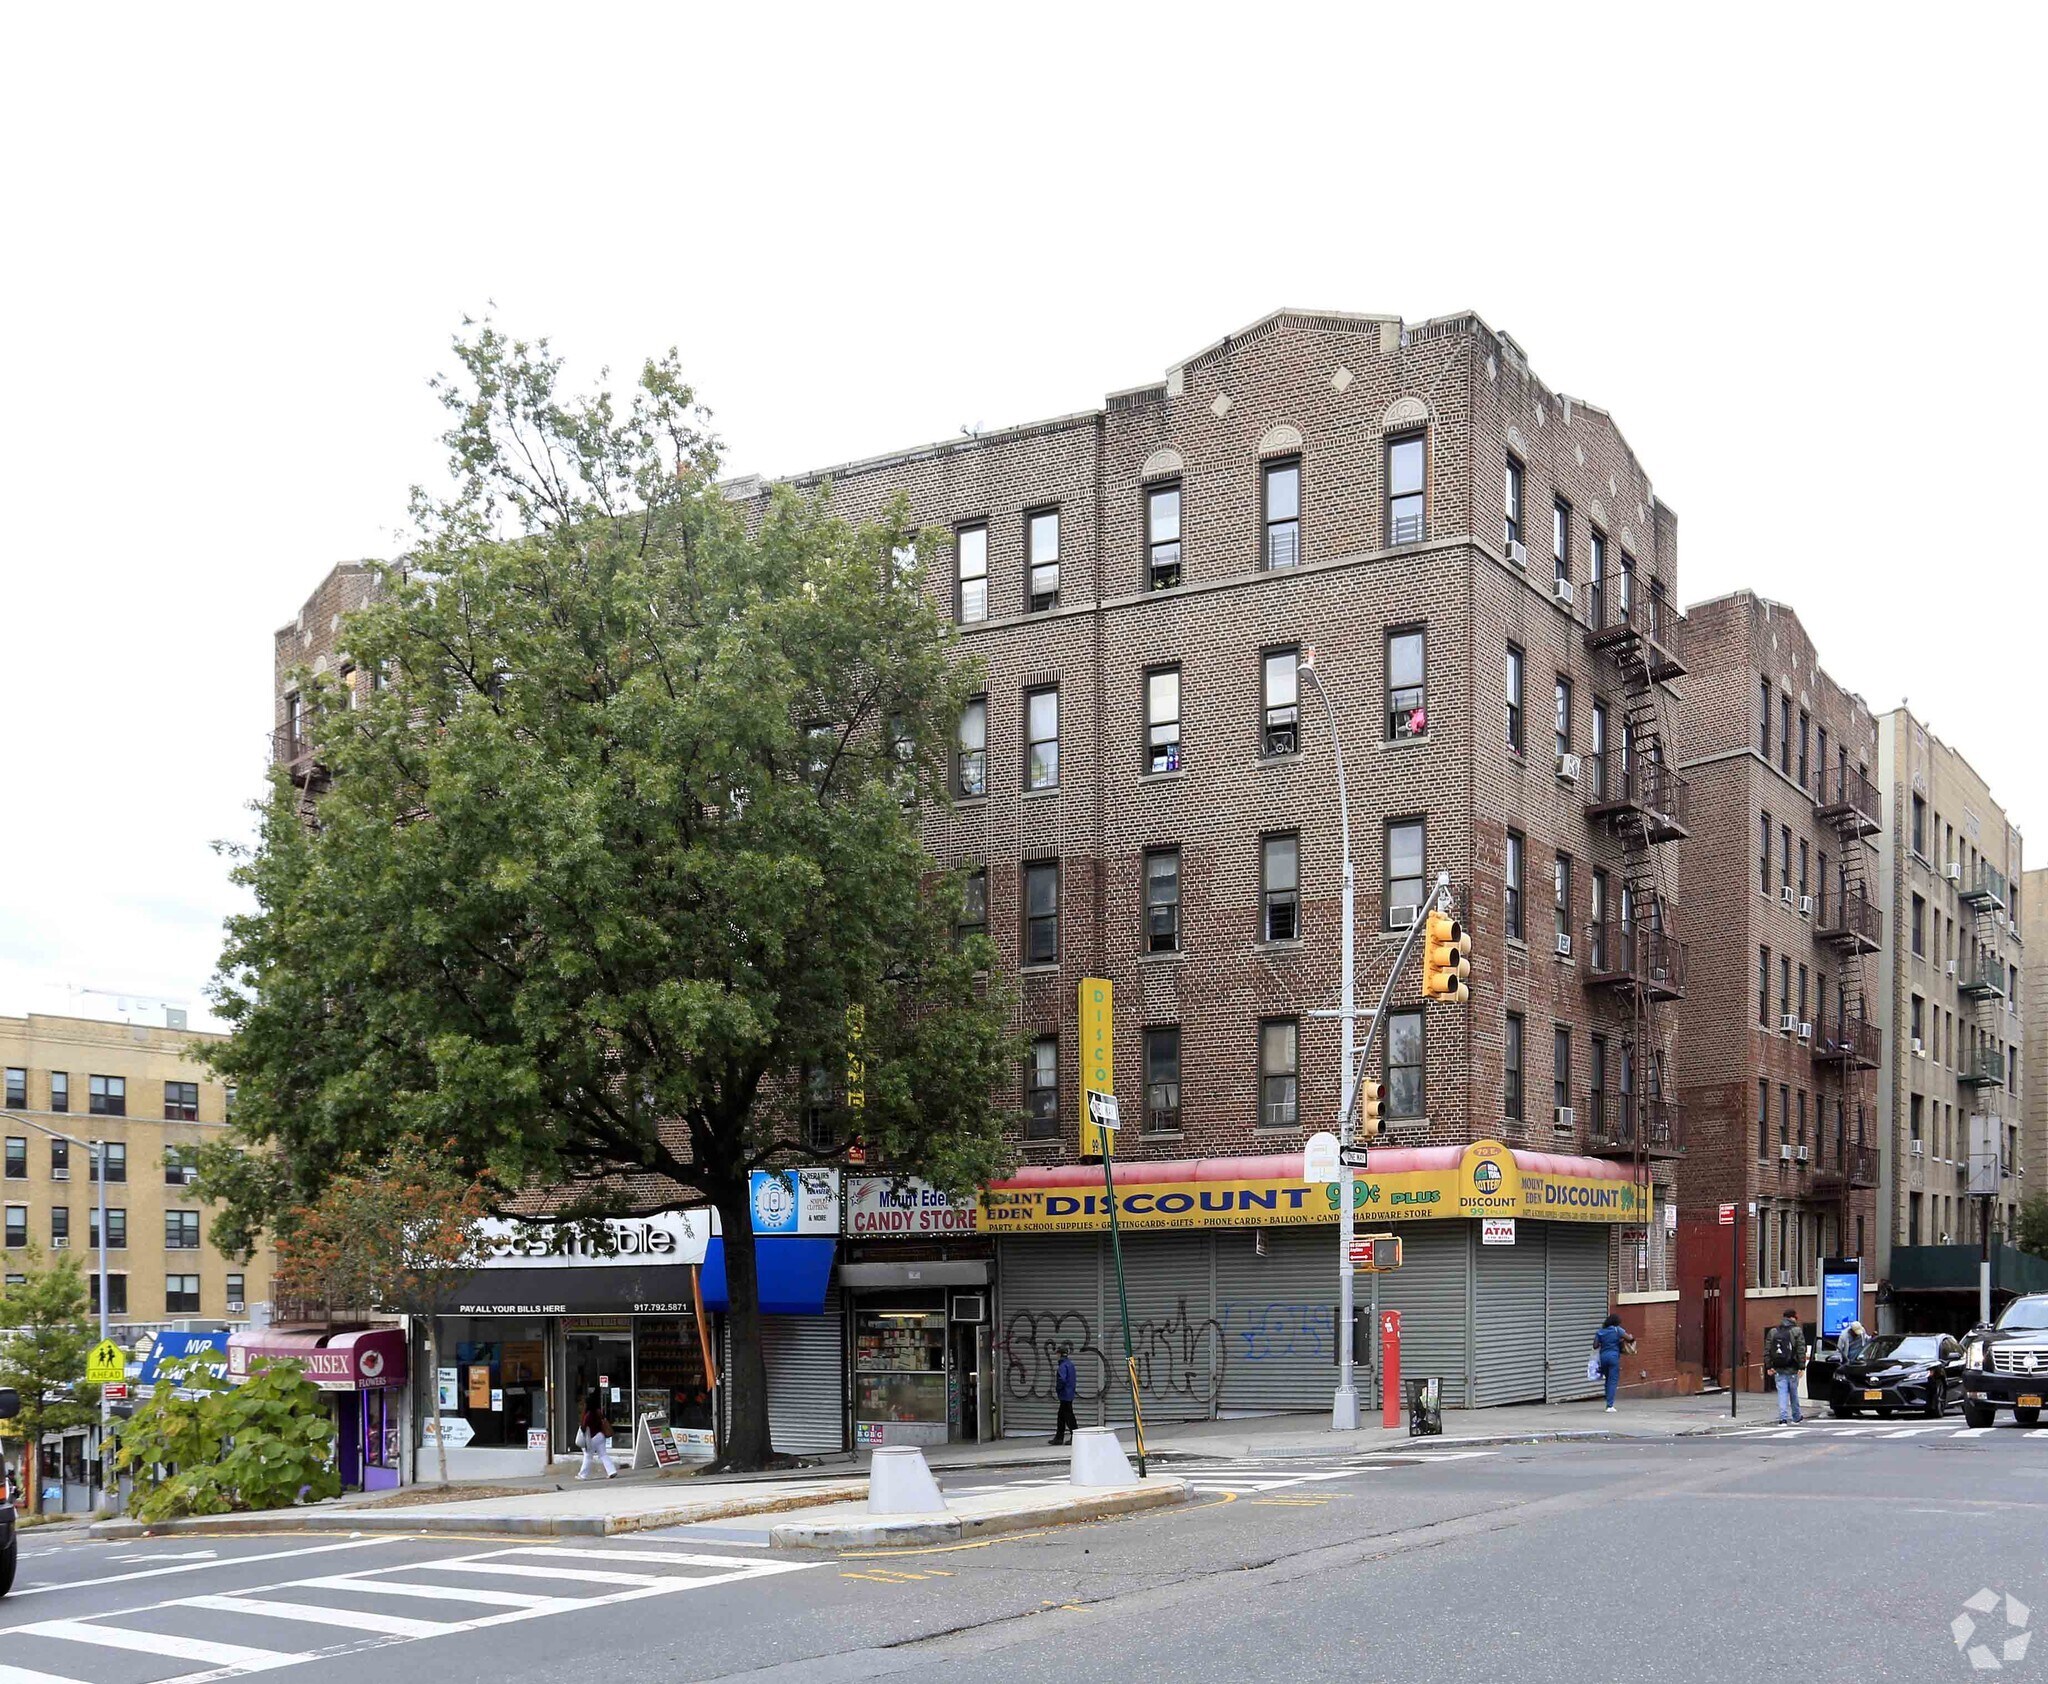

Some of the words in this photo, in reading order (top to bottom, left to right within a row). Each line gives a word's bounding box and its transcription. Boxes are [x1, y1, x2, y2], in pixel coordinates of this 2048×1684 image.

[1347, 1153, 1356, 1161] ONE
[1356, 1154, 1365, 1162] WAY
[1521, 1177, 1544, 1191] MOUNT
[1045, 1187, 1312, 1216] DISCOUNT
[1390, 1190, 1441, 1205] PLUS
[1525, 1192, 1542, 1204] EDEN
[1545, 1184, 1619, 1208] DISCOUNT
[1460, 1197, 1516, 1207] DISCOUNT
[813, 1214, 827, 1222] MORE
[986, 1207, 1034, 1220] EDEN
[854, 1210, 915, 1232] CANDY
[919, 1208, 977, 1231] STORE
[988, 1223, 1013, 1232] PARTY
[1016, 1223, 1022, 1231] &
[1023, 1222, 1054, 1231] SCHOOL
[1055, 1221, 1093, 1230] SUPPLIES
[1170, 1218, 1194, 1227] GIFTS
[1203, 1217, 1232, 1226] PHONE
[1234, 1216, 1262, 1225] CARDS
[1269, 1214, 1308, 1224] BALLOON
[1316, 1213, 1341, 1222] CAND
[1353, 1210, 1401, 1220] HARDWARE
[1403, 1209, 1433, 1218] STORE
[1484, 1227, 1513, 1236] ATM
[460, 1305, 476, 1313] PAY
[476, 1305, 491, 1313] ALL
[491, 1305, 516, 1313] YOUR
[517, 1305, 541, 1313] BILLS
[543, 1304, 567, 1313] HERE
[633, 1303, 687, 1312] 917.792.5871
[91, 1371, 121, 1379] AHEAD
[359, 1377, 387, 1388] FLOWERS
